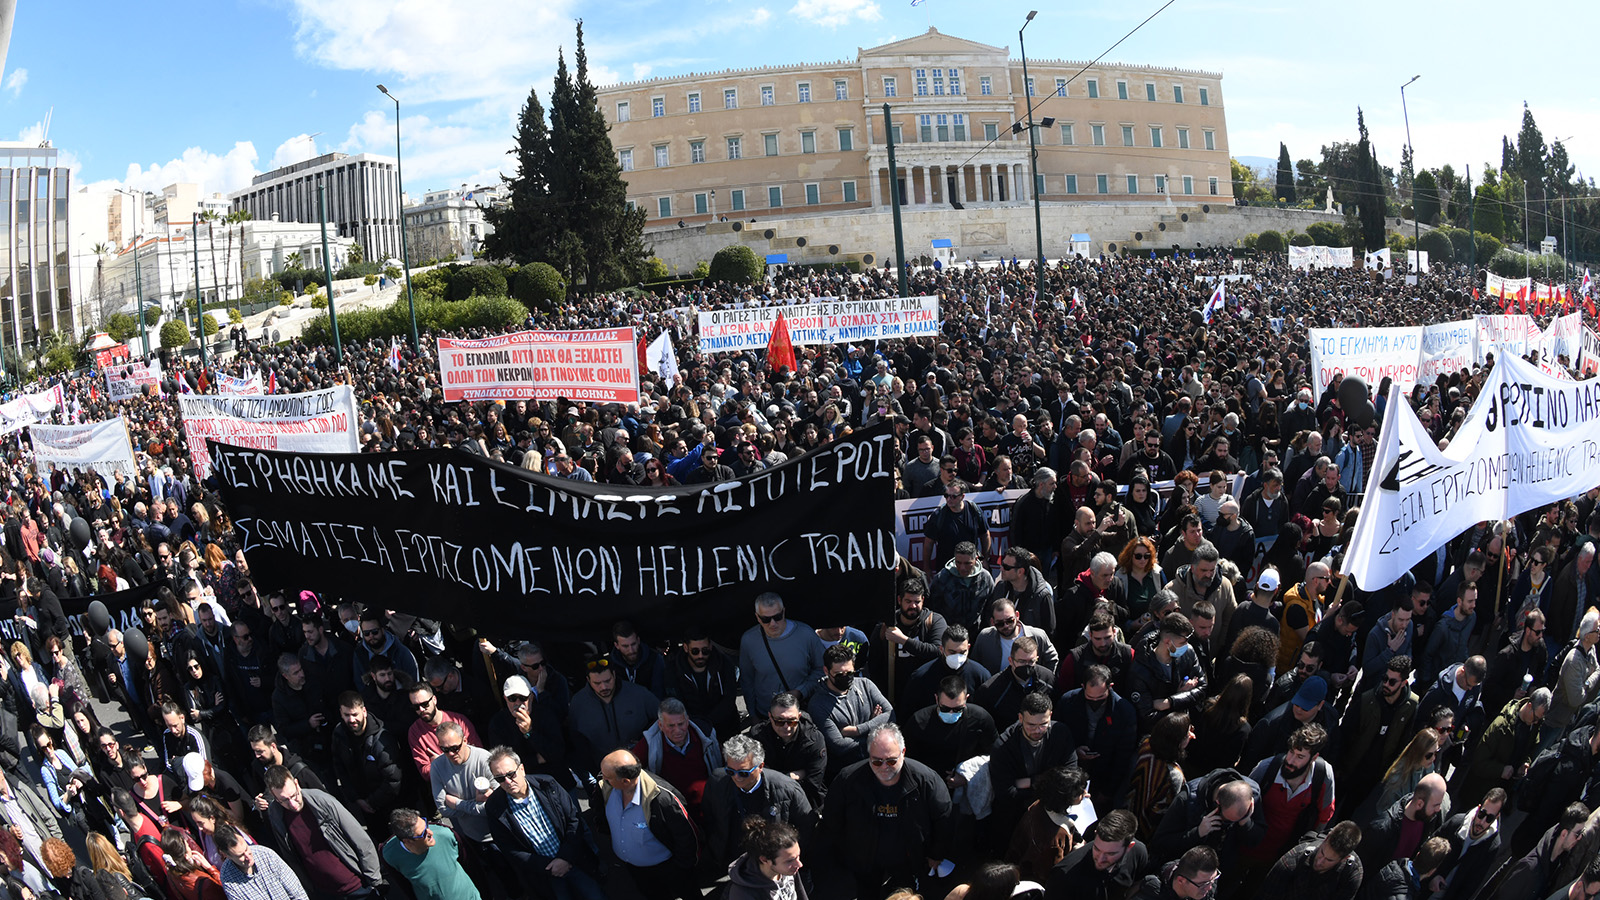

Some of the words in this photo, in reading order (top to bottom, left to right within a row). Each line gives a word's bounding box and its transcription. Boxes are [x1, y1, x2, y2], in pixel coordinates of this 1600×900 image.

[712, 313, 721, 324] ΟΙ
[724, 310, 751, 323] ΡΑΓΕΣ
[752, 309, 772, 321] ΤΗΣ
[776, 304, 830, 319] ΑΝΑΠΤΥΞΗΣ
[833, 301, 880, 315] ΒΑΦΤΗΚΑΝ
[884, 300, 897, 311] ΜΕ
[900, 298, 922, 310] ΑΙΜΑ
[702, 326, 715, 337] ΜΕ
[720, 323, 750, 336] ΑΓΩΝΑ
[754, 322, 766, 332] ΘΑ
[828, 316, 838, 327] ΤΑ
[841, 314, 879, 327] ΘΥΜΑΤΑ
[880, 312, 900, 324] ΣΤΑ
[903, 310, 934, 322] ΤΡΕΝΑ
[511, 333, 570, 342] ΟΙΚΟΔΟΜΩΝ
[571, 331, 618, 342] ΕΛΛΑΔΑΣ
[701, 335, 743, 350] ΣΥΝΔΙΚΑΤΟ
[792, 329, 828, 342] ΑΤΤΙΚΗΣ
[904, 320, 938, 334] ΕΛΛΑΔΑΣ
[1320, 338, 1336, 356] ΤΟ
[1340, 335, 1388, 356] ΕΓΚΛΗΜΑ
[1392, 334, 1417, 352] ΑΥΤΟ
[452, 353, 464, 366] ΤΟ
[466, 350, 510, 366] ΕΓΚΛΗΜΑ
[512, 350, 534, 364] ΑΥΤΟ
[537, 349, 556, 364] ΔΕΝ
[558, 348, 573, 364] ΘΑ
[575, 348, 622, 364] ΞΕΧΑΣΤΕΙ
[448, 370, 474, 384] ΟΛΩΝ
[476, 368, 496, 382] ΤΩΝ
[497, 367, 532, 382] ΝΕΚΡΩΝ
[534, 368, 549, 382] ΘΑ
[550, 367, 596, 382] ΓΙΝΟΥΜΕ
[597, 368, 631, 384] ΦΩΝΗ
[1379, 364, 1418, 382] ΝΕΚΡΩΝ
[464, 388, 514, 398] ΣΥΝΔΙΚΑΤΟ
[516, 388, 574, 398] ΟΙΚΟΔΟΜΩΝ
[576, 389, 617, 400] ΑΘΗΝΑΣ
[208, 444, 415, 500] ΜΕΤΡΗΘΗΚΑΜΕ
[428, 463, 481, 507] ΚΑΙ
[490, 467, 681, 521] ΕΙΜΑΣΤΕ
[235, 517, 394, 573] ΣΩΜΑΤΕΙΑ
[394, 529, 622, 596] ΕΡΓΑΖΟΜΕΝΩΝ
[638, 538, 796, 596] HELLENIC
[800, 528, 896, 574] TRAIN
